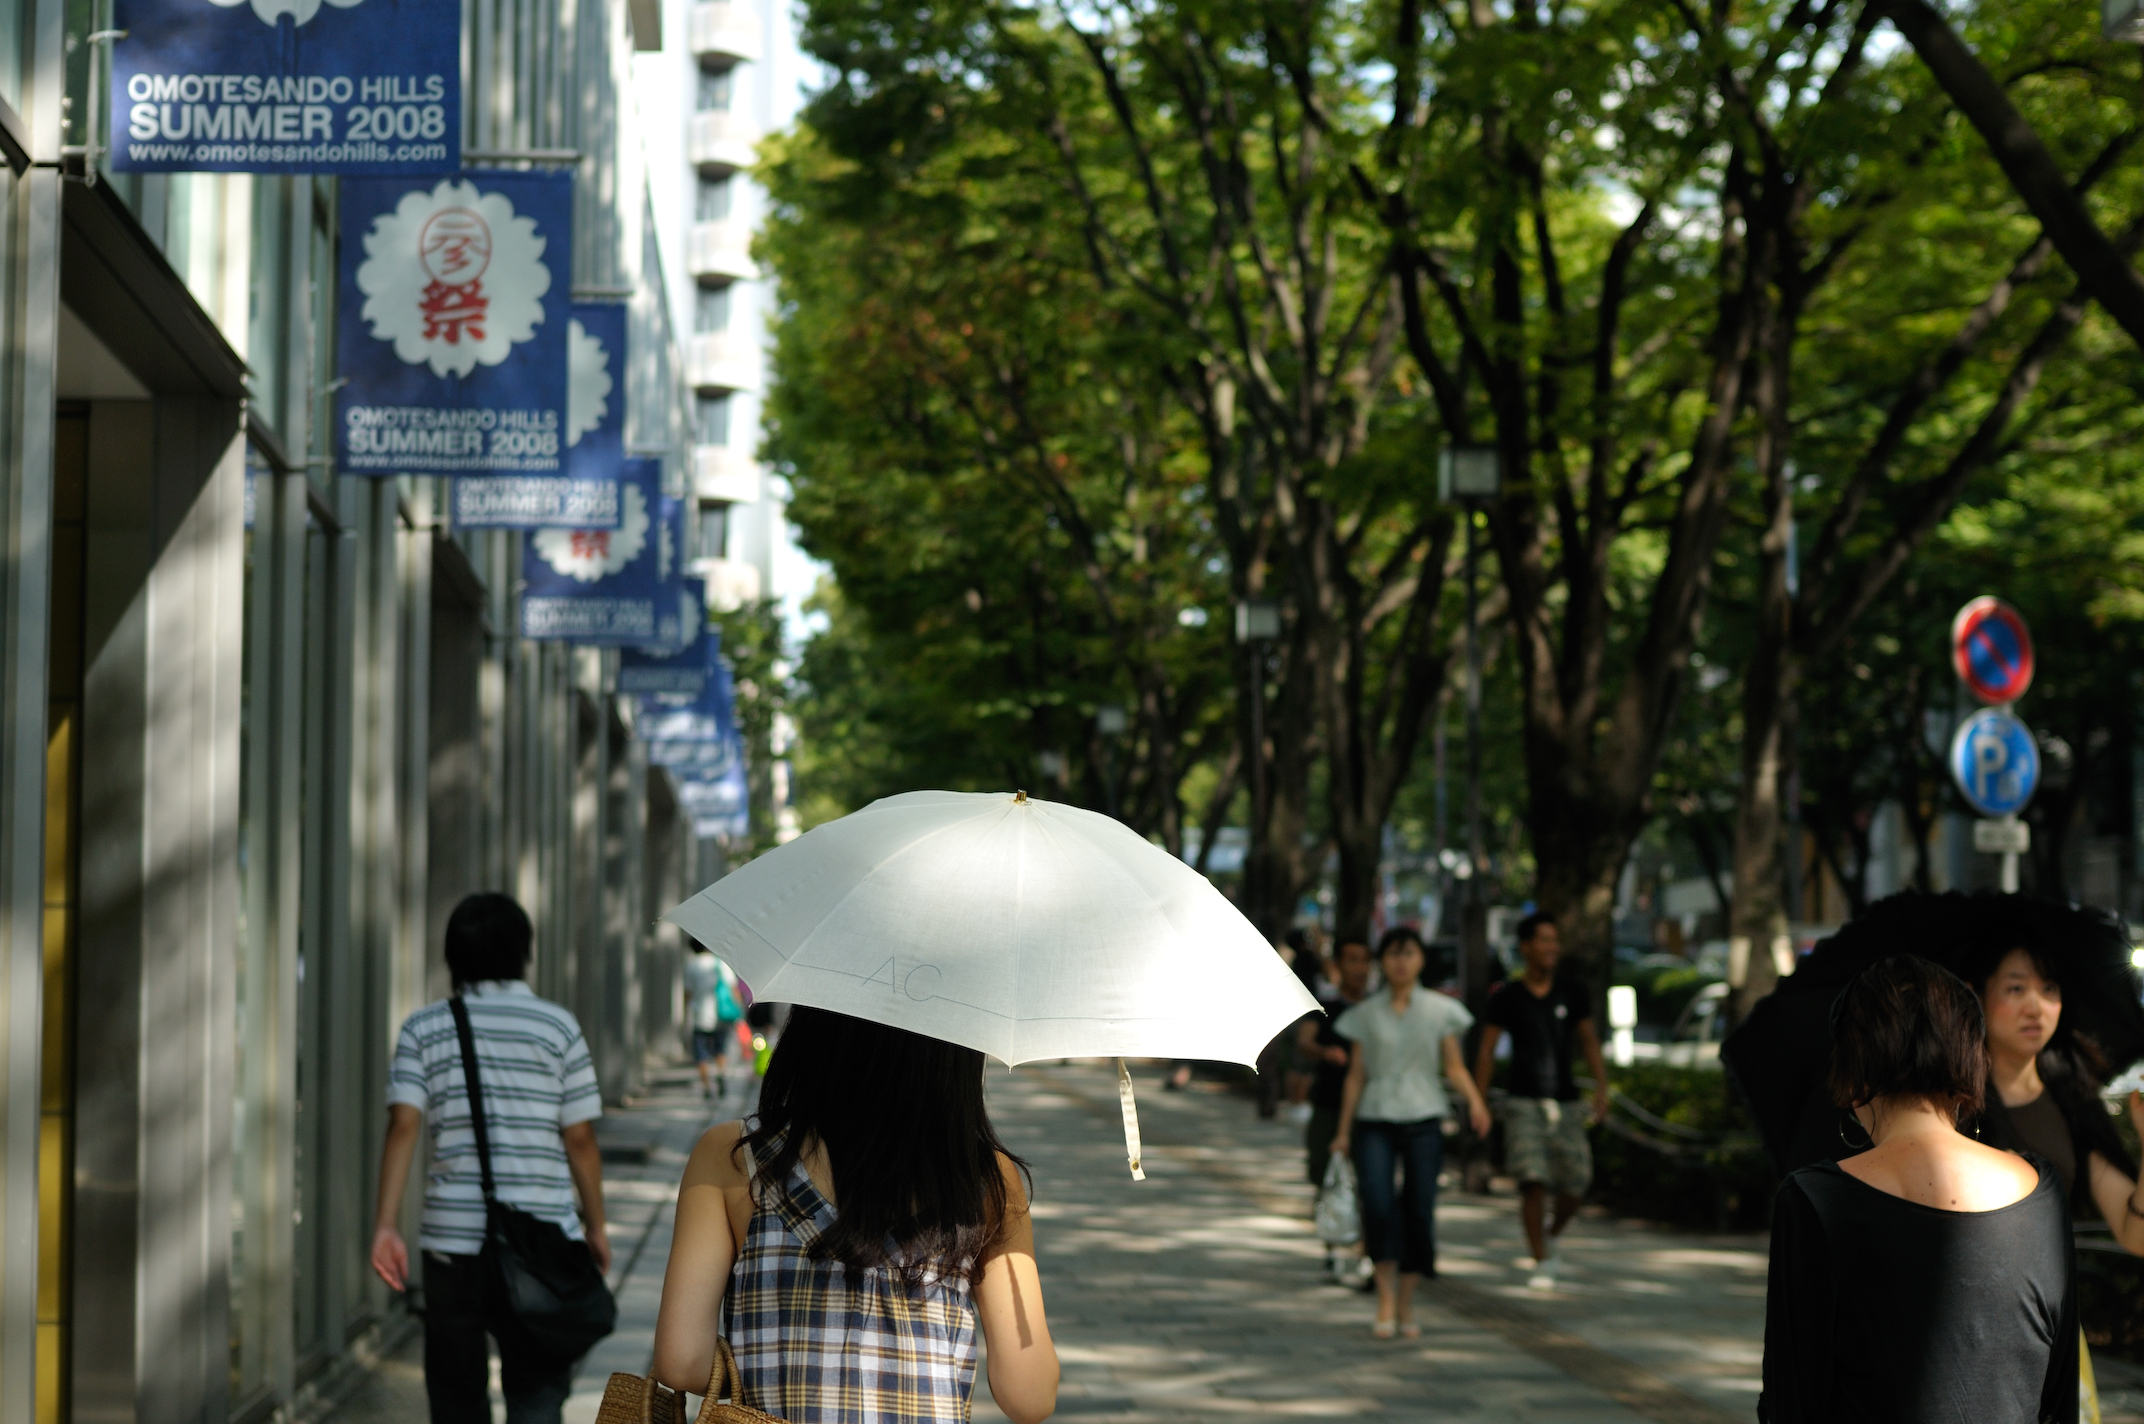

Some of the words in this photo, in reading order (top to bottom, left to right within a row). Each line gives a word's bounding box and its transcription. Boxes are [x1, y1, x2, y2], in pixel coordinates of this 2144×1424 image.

[128, 73, 353, 103] OMOTESANDO
[361, 75, 444, 102] HILLS
[128, 103, 333, 141] SUMMER
[347, 104, 446, 140] 2008
[128, 142, 447, 162] www.omotesandohills.com
[346, 406, 497, 430] OMOTESANDO
[501, 409, 558, 430] HILLS
[347, 429, 483, 454] SUMMER
[490, 430, 559, 455] 2008
[1974, 734, 2007, 799] P
[862, 955, 942, 1002] AC
